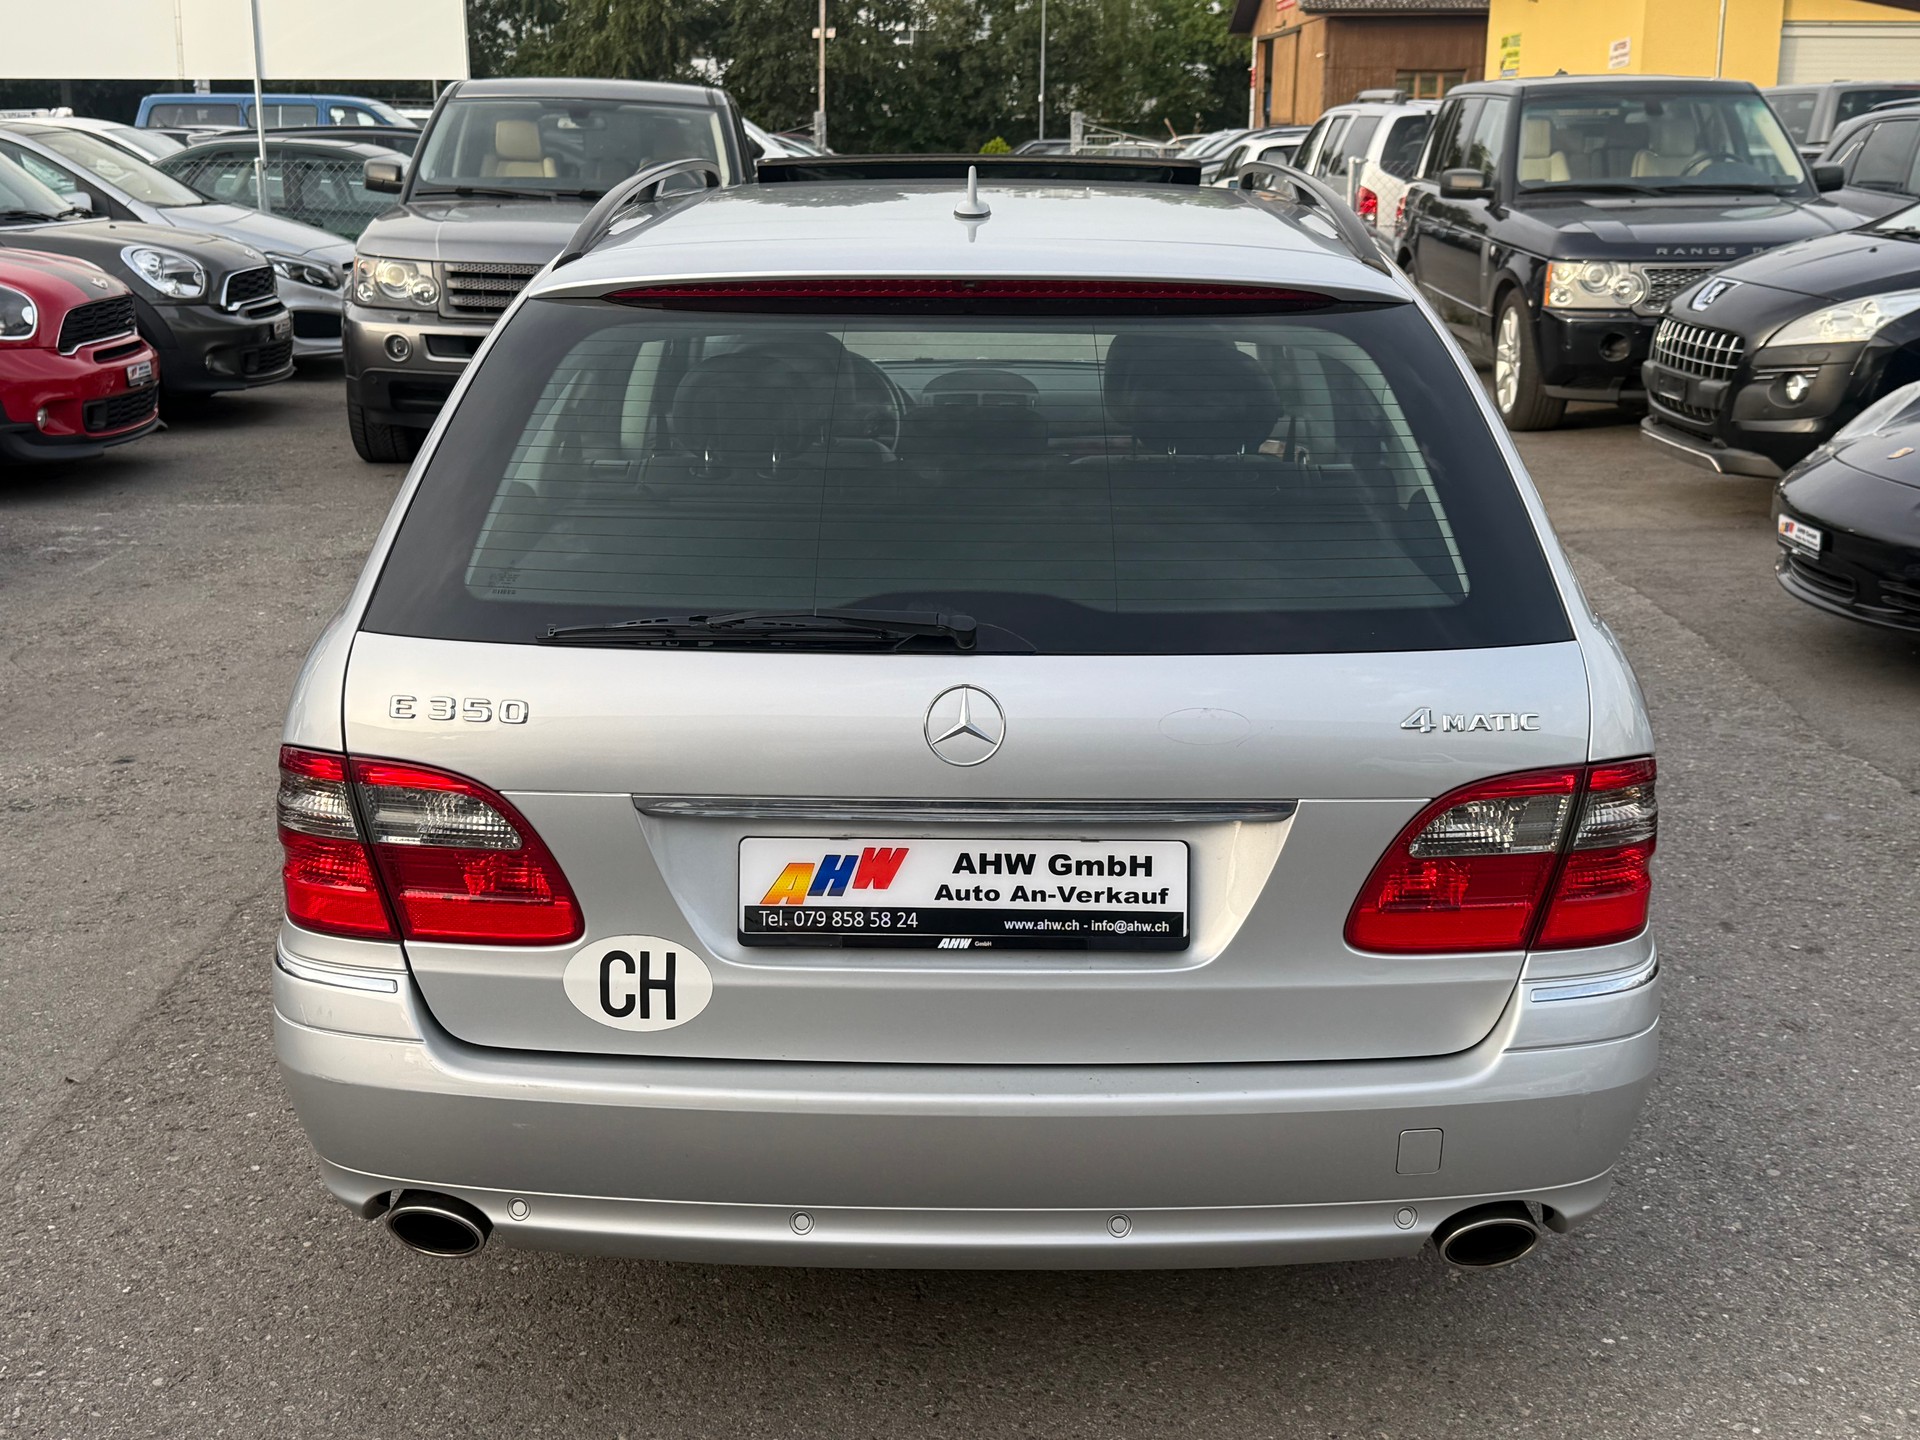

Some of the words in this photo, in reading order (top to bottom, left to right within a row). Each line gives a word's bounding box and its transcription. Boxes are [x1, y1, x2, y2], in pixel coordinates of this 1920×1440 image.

[1656, 247, 1736, 255] RANGE
[389, 694, 417, 719] E
[428, 695, 529, 724] 350
[952, 853, 1036, 875] AHW
[1048, 853, 1153, 877] GmbH
[760, 847, 910, 905] AHW
[934, 884, 1001, 901] Auto
[1010, 885, 1169, 905] An-Verkauf
[759, 910, 788, 927] Tel.
[794, 911, 826, 927] 079
[832, 911, 864, 928] 858
[869, 912, 891, 928] 58
[896, 912, 918, 929] 24
[1004, 919, 1080, 931] www.ahw.ch
[1091, 920, 1170, 934] info@ahw.ch
[937, 938, 972, 949] AHW
[600, 950, 676, 1020] CH
